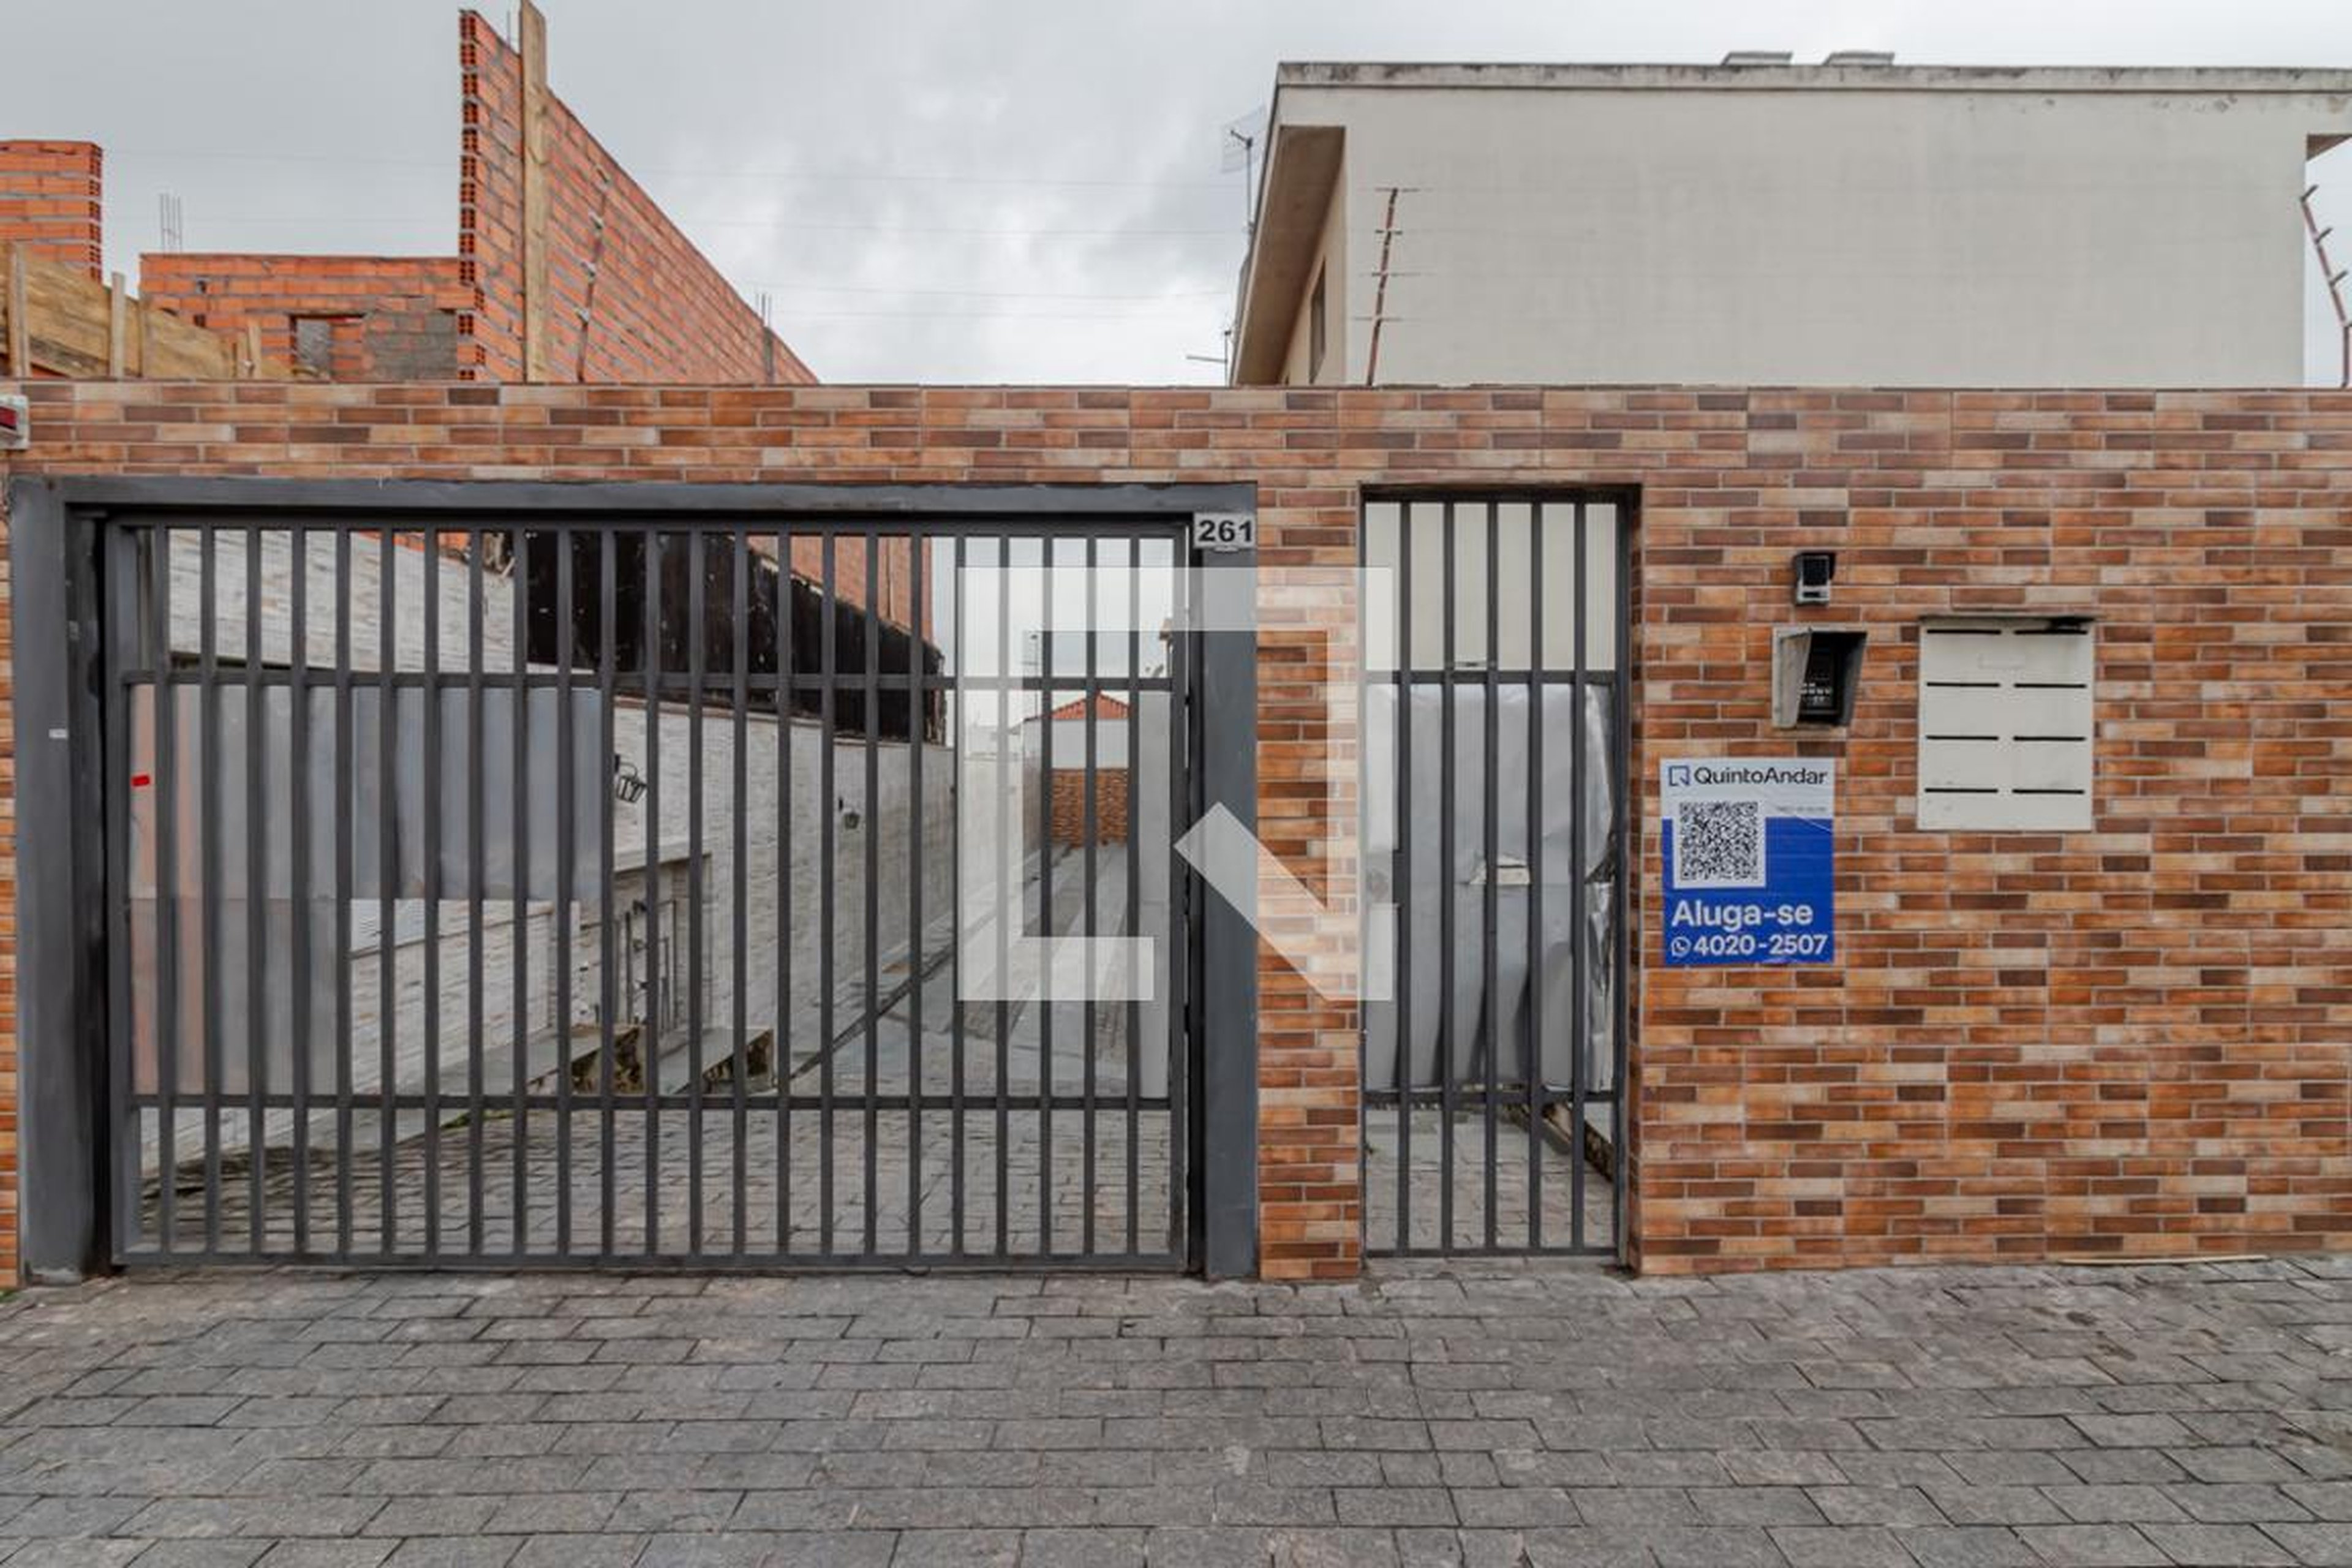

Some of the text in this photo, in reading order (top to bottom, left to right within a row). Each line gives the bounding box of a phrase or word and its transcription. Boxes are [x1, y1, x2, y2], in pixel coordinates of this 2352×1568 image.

[1198, 519, 1252, 543] 261
[1694, 766, 1828, 785] QuintoAndar
[1672, 899, 1814, 932] Aluga-se
[1694, 933, 1828, 956] 4020-2507
